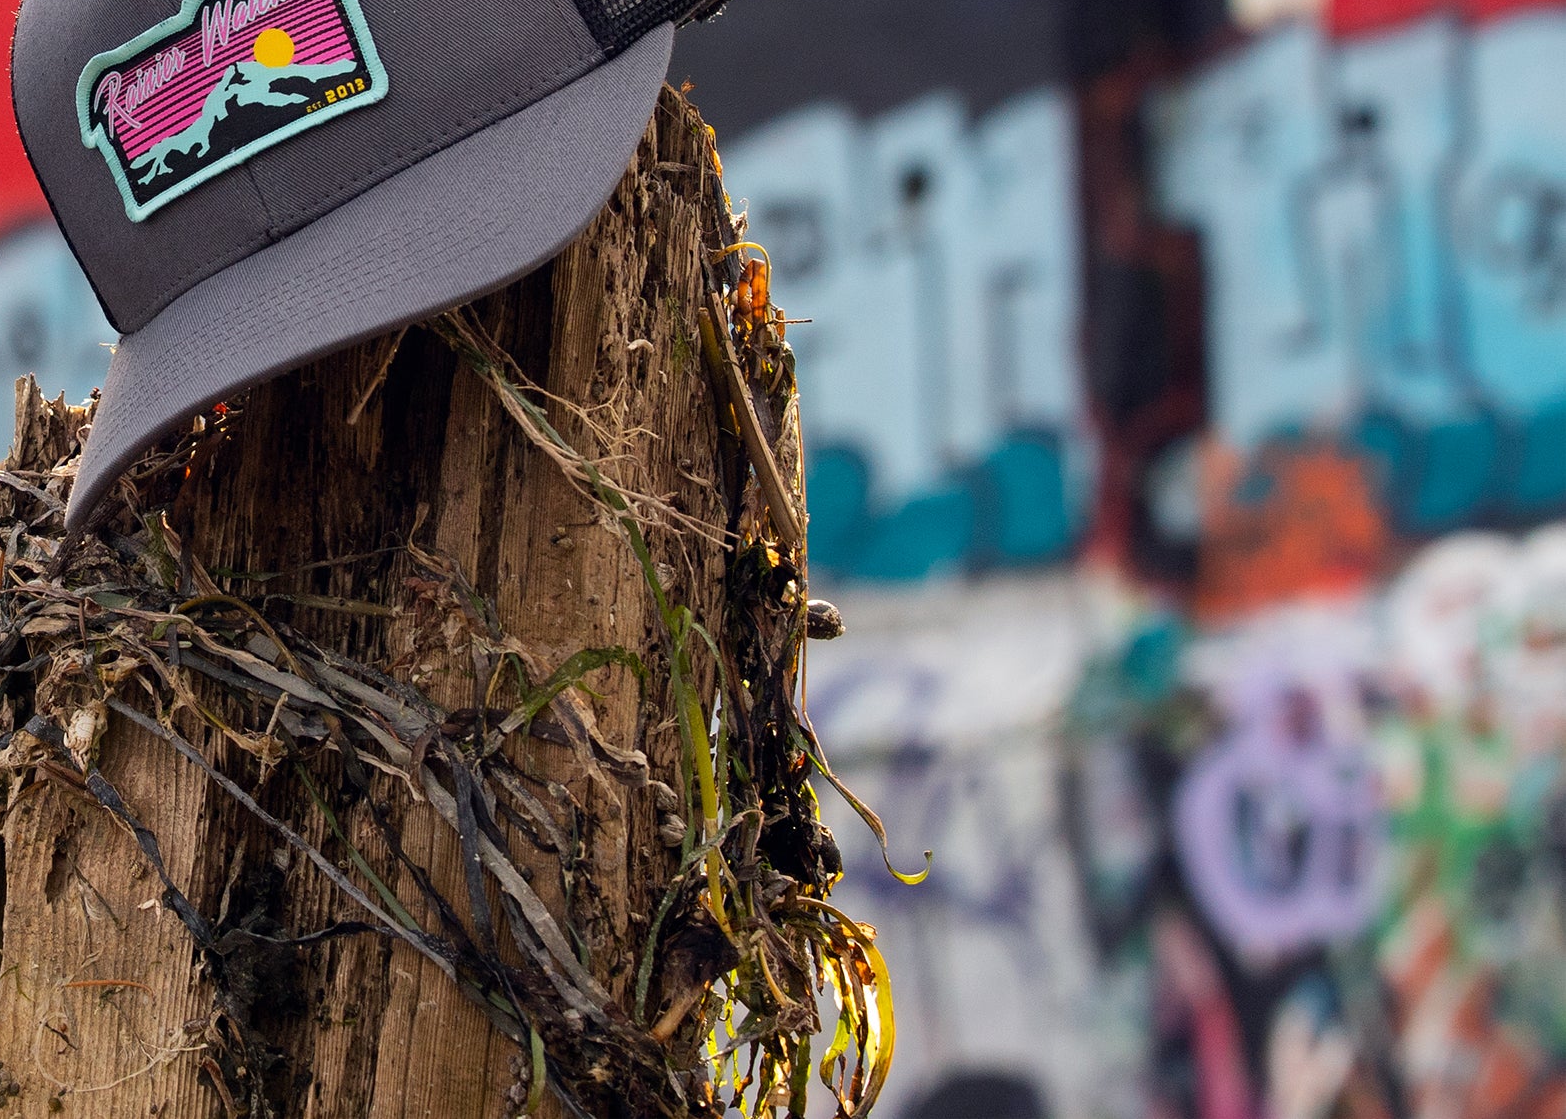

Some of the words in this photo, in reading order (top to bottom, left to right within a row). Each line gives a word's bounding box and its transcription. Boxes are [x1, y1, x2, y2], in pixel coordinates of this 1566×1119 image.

[93, 47, 186, 137] Rainier
[305, 100, 326, 114] EST.
[324, 77, 366, 104] 2013
